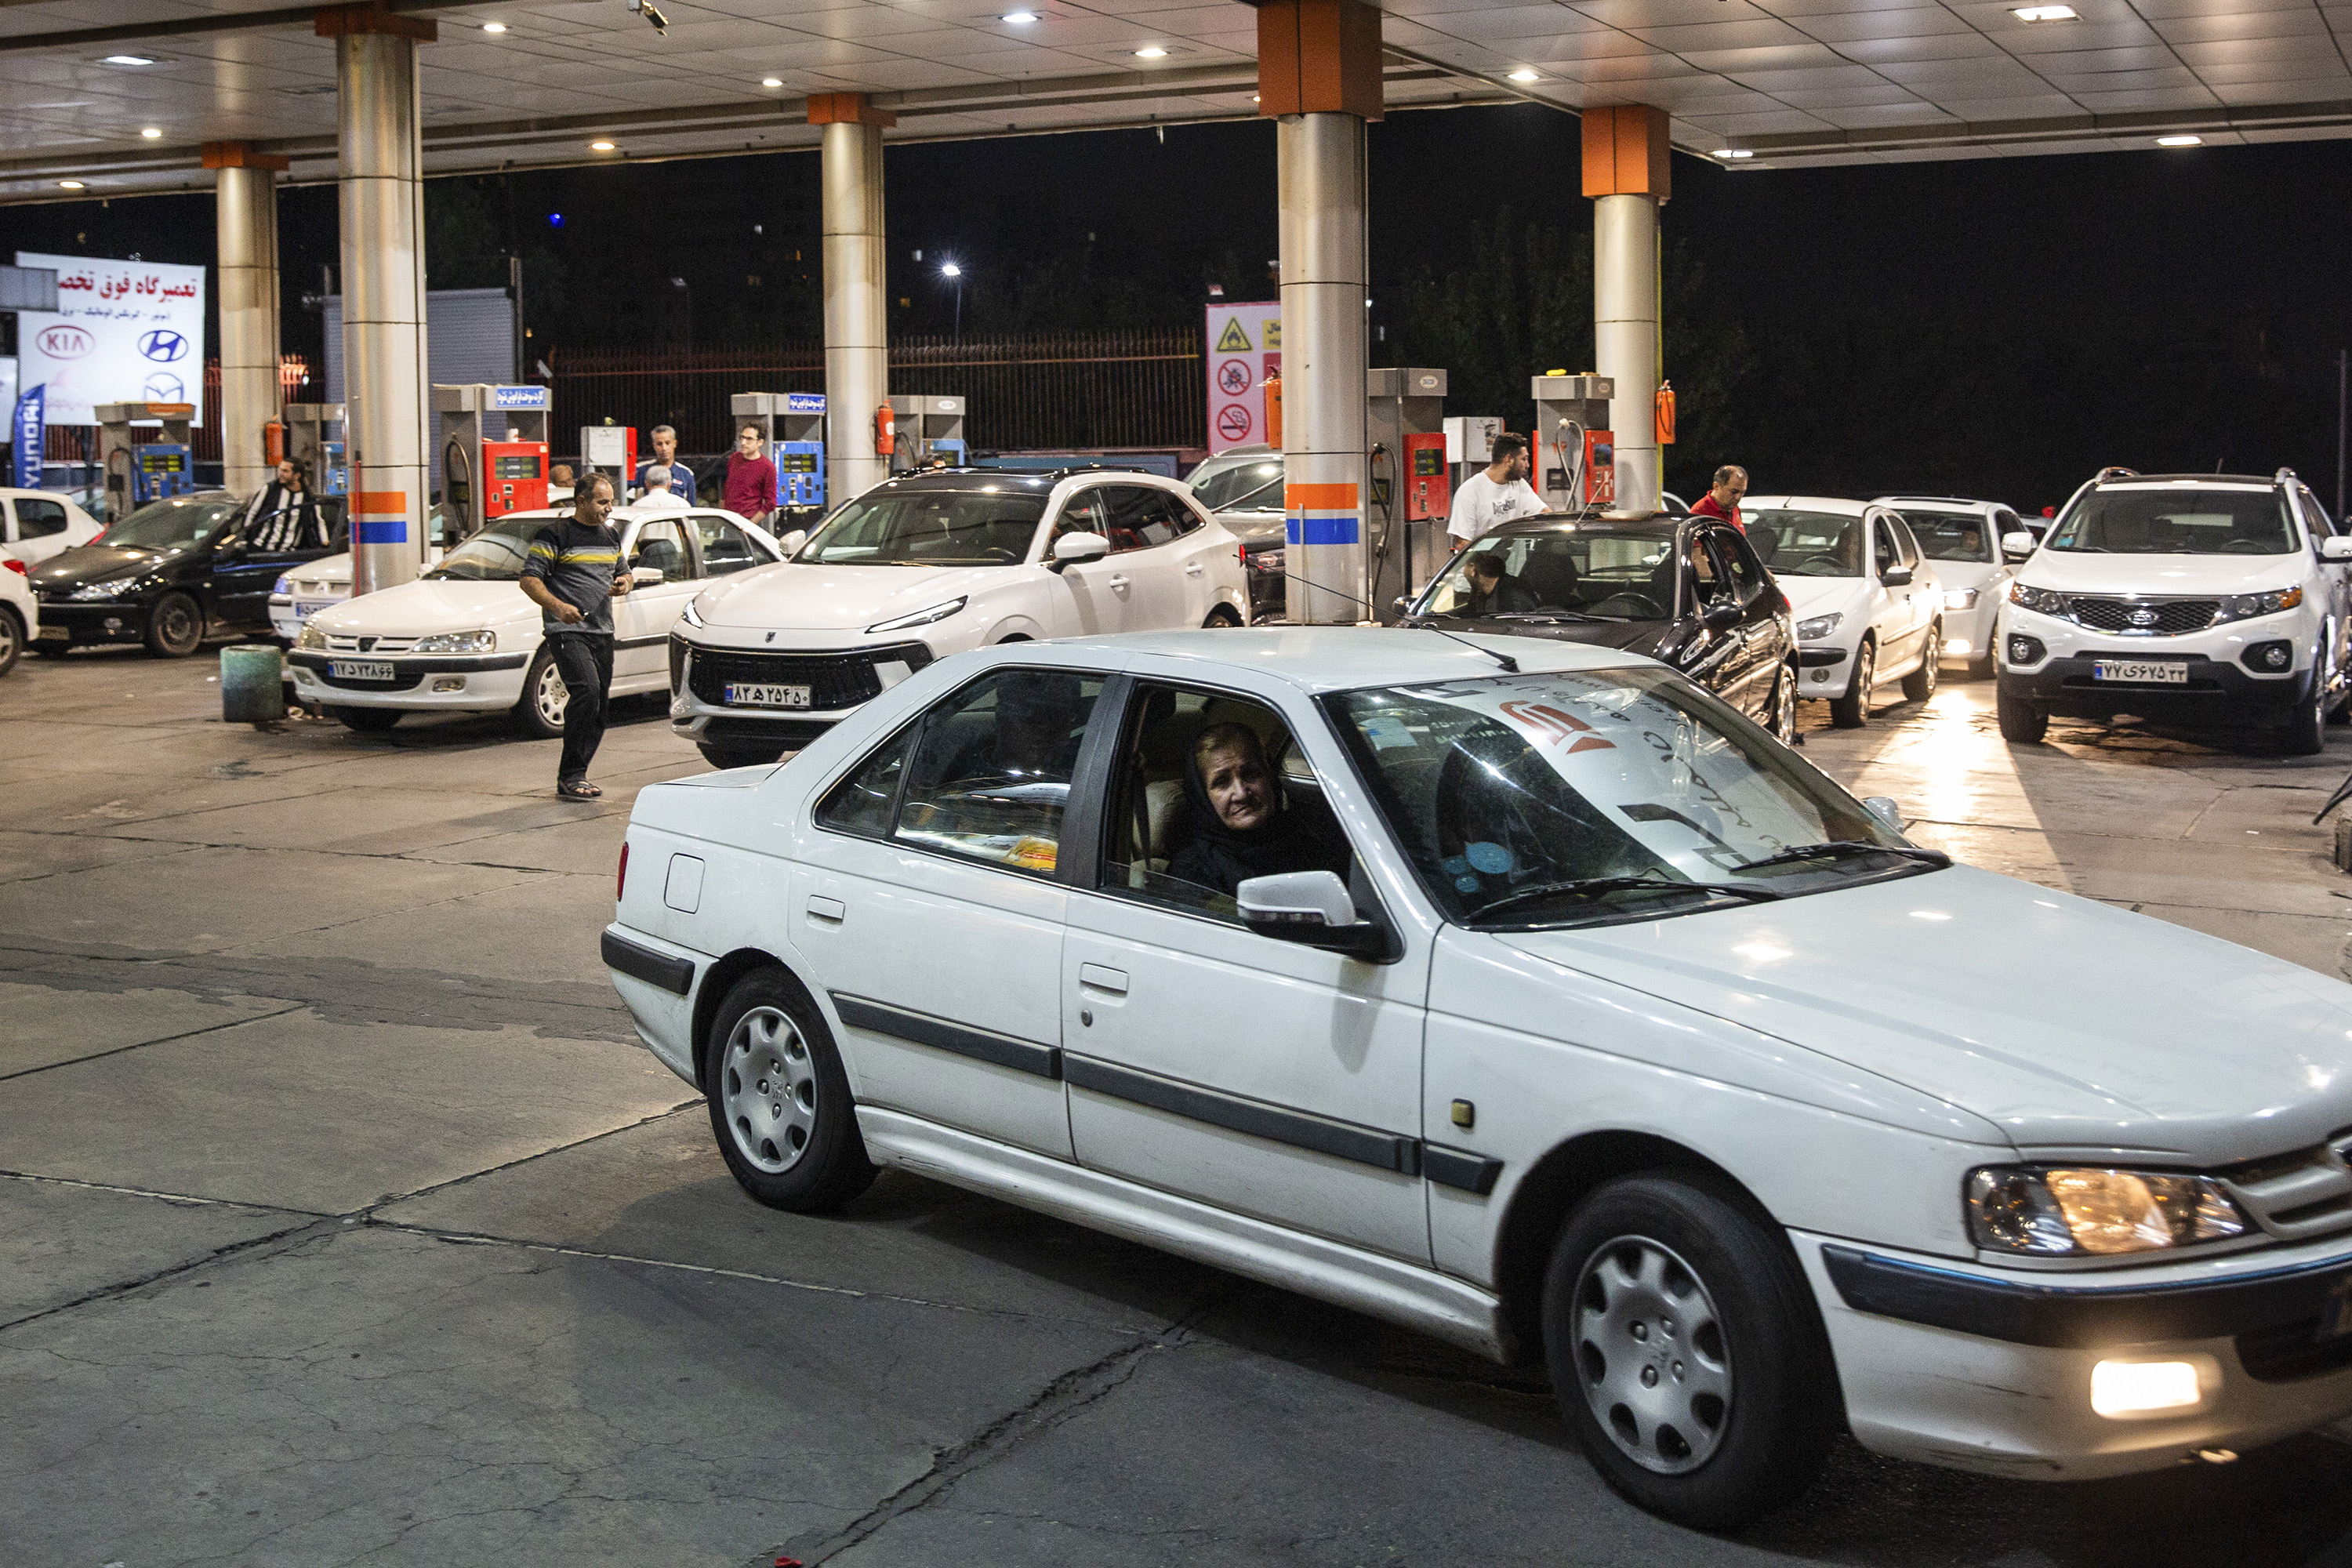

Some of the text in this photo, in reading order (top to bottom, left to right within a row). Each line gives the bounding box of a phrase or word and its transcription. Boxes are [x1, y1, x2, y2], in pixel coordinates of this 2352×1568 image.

[100, 270, 129, 299] فوق
[136, 275, 196, 303] تعمیرگاه
[47, 334, 85, 351] KIA
